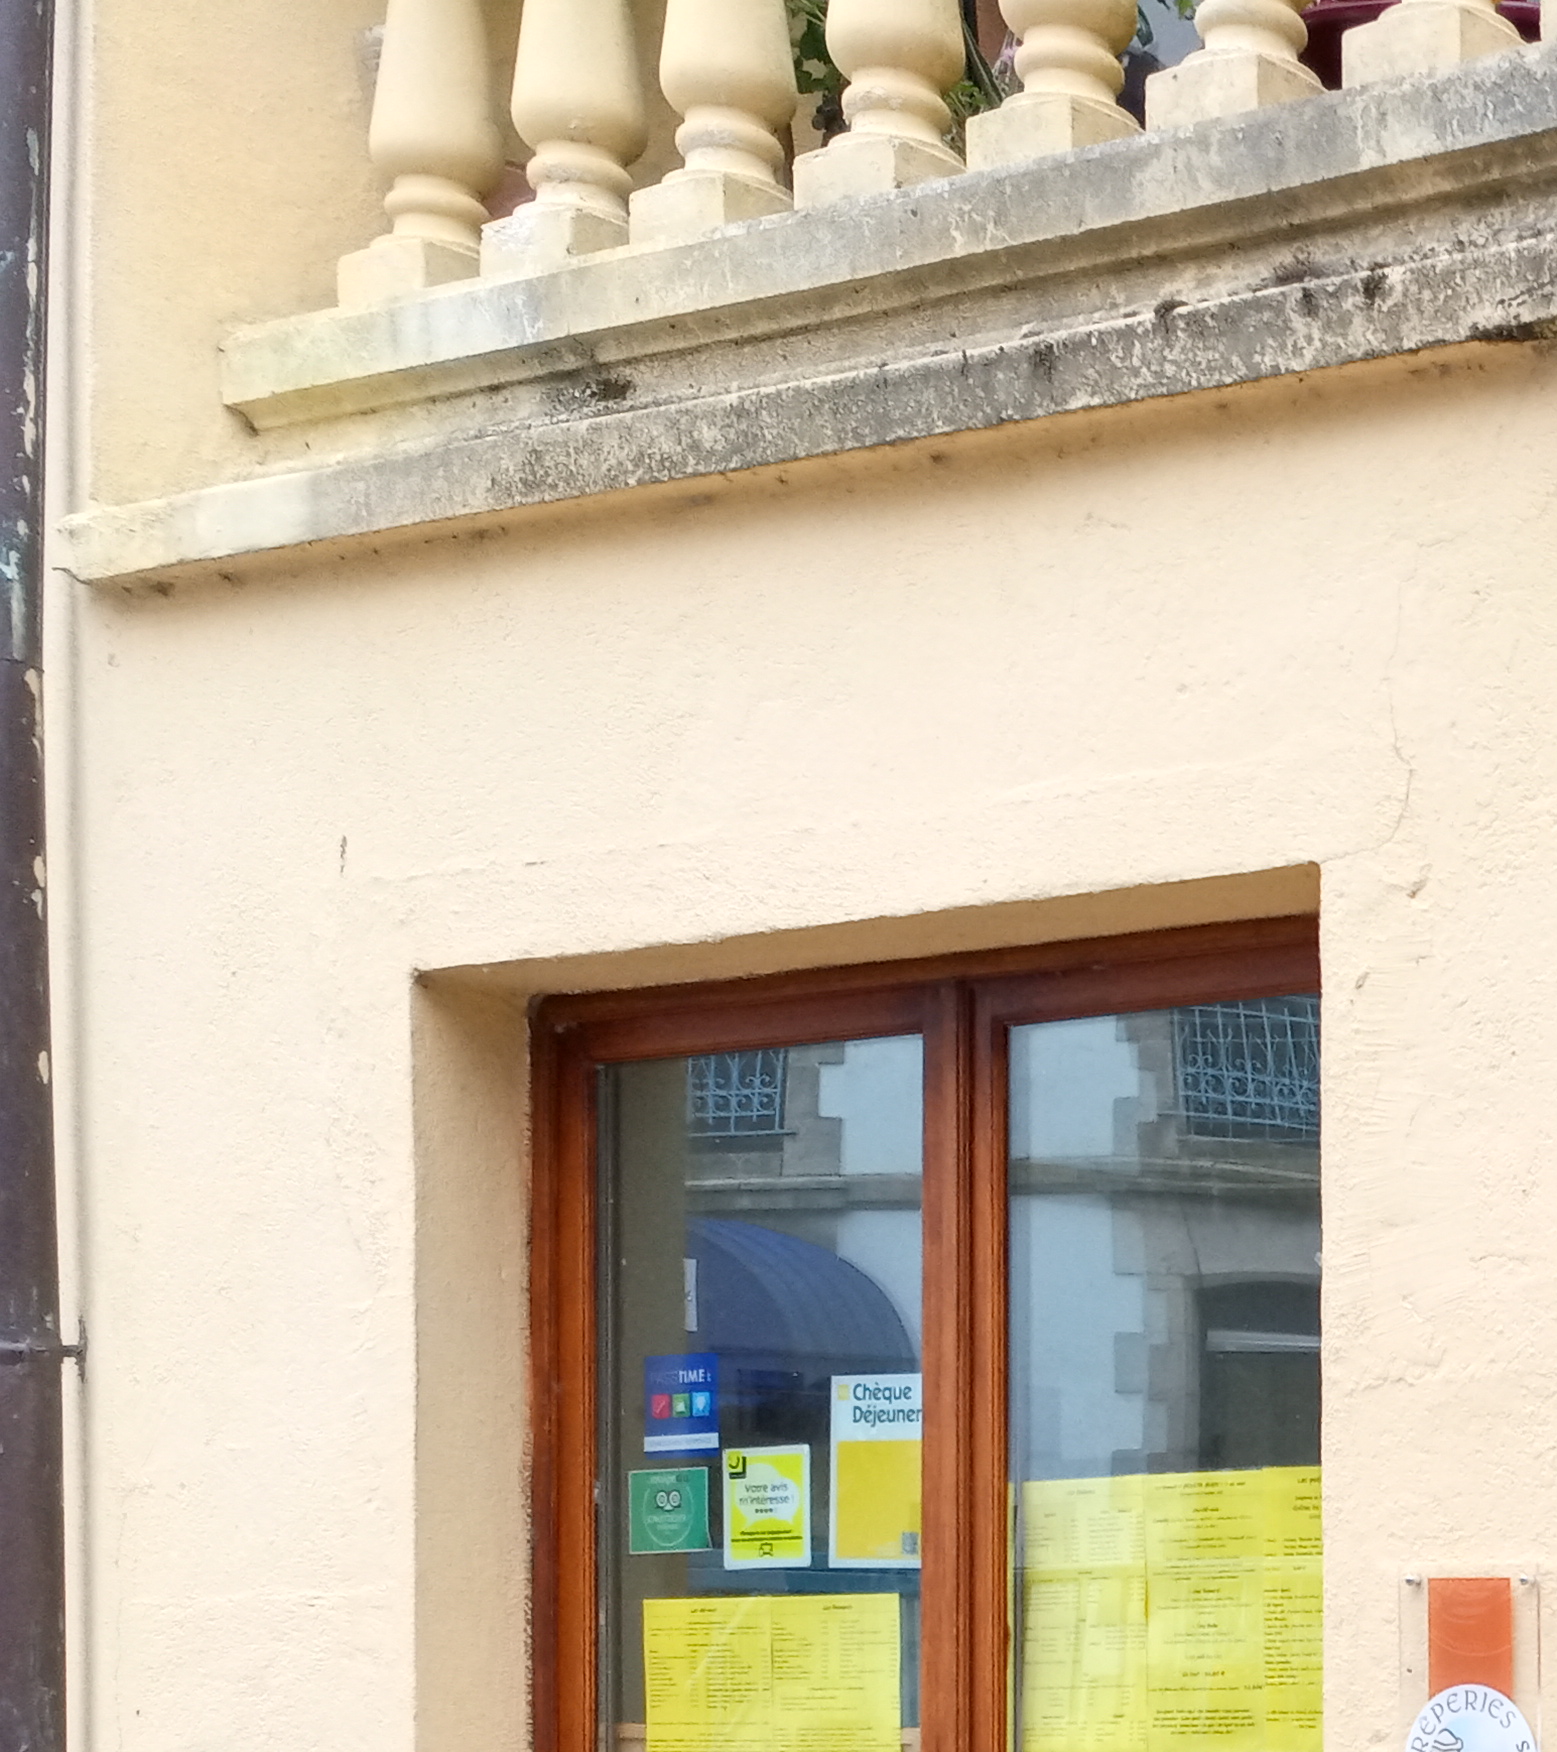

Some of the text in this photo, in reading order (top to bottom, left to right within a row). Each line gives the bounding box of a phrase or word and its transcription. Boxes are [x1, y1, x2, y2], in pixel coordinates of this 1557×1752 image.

[853, 1382, 912, 1404] Chèque
[853, 1405, 922, 1427] Déjeuner
[745, 1483, 788, 1493] Votre avis
